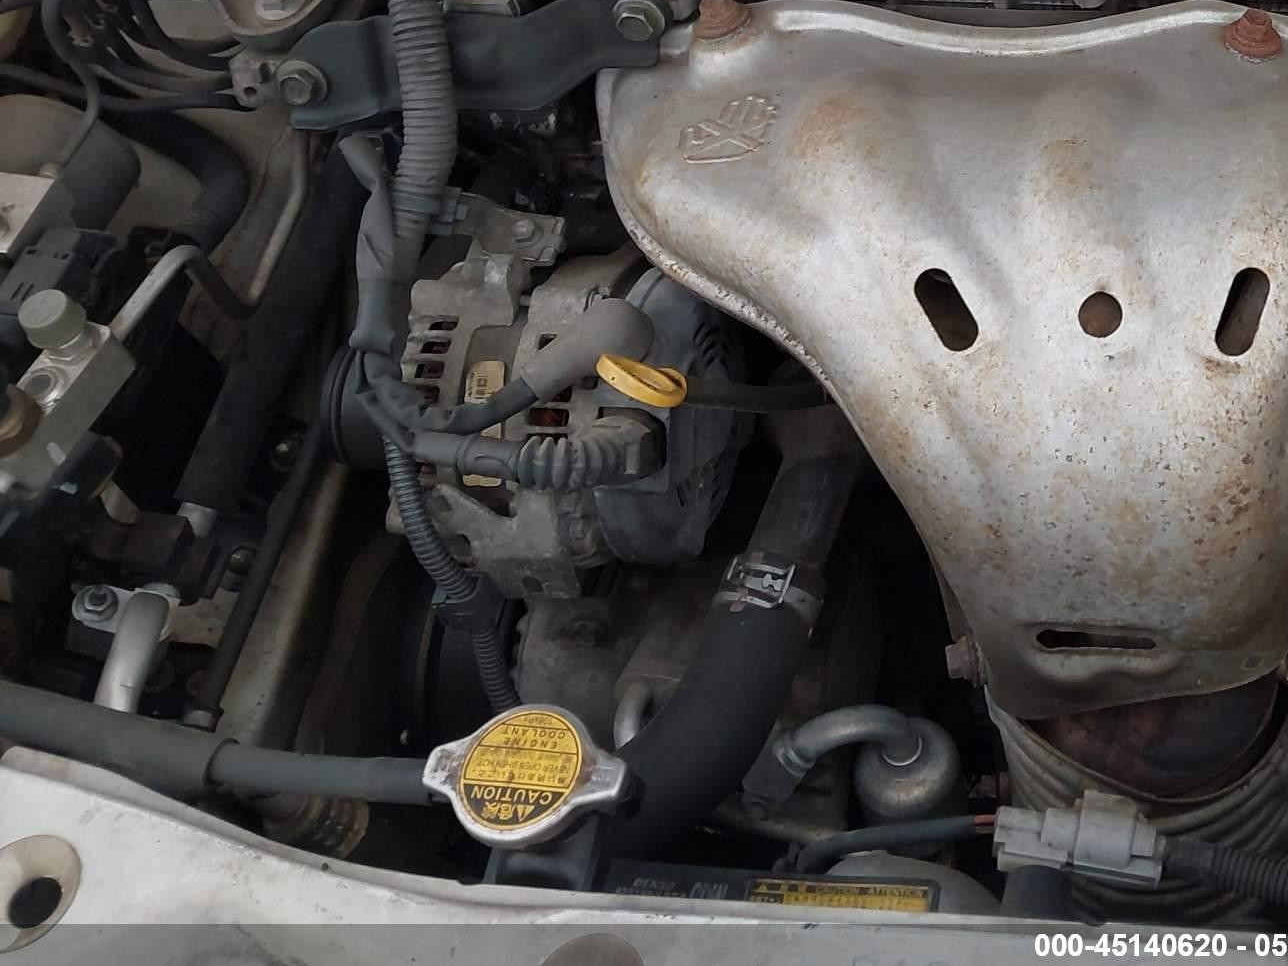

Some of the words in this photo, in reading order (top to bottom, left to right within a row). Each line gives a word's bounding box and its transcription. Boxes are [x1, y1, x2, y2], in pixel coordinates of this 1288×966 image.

[502, 726, 566, 739] COOLANT
[503, 738, 557, 749] ENGINE
[471, 786, 552, 804] CAUTION
